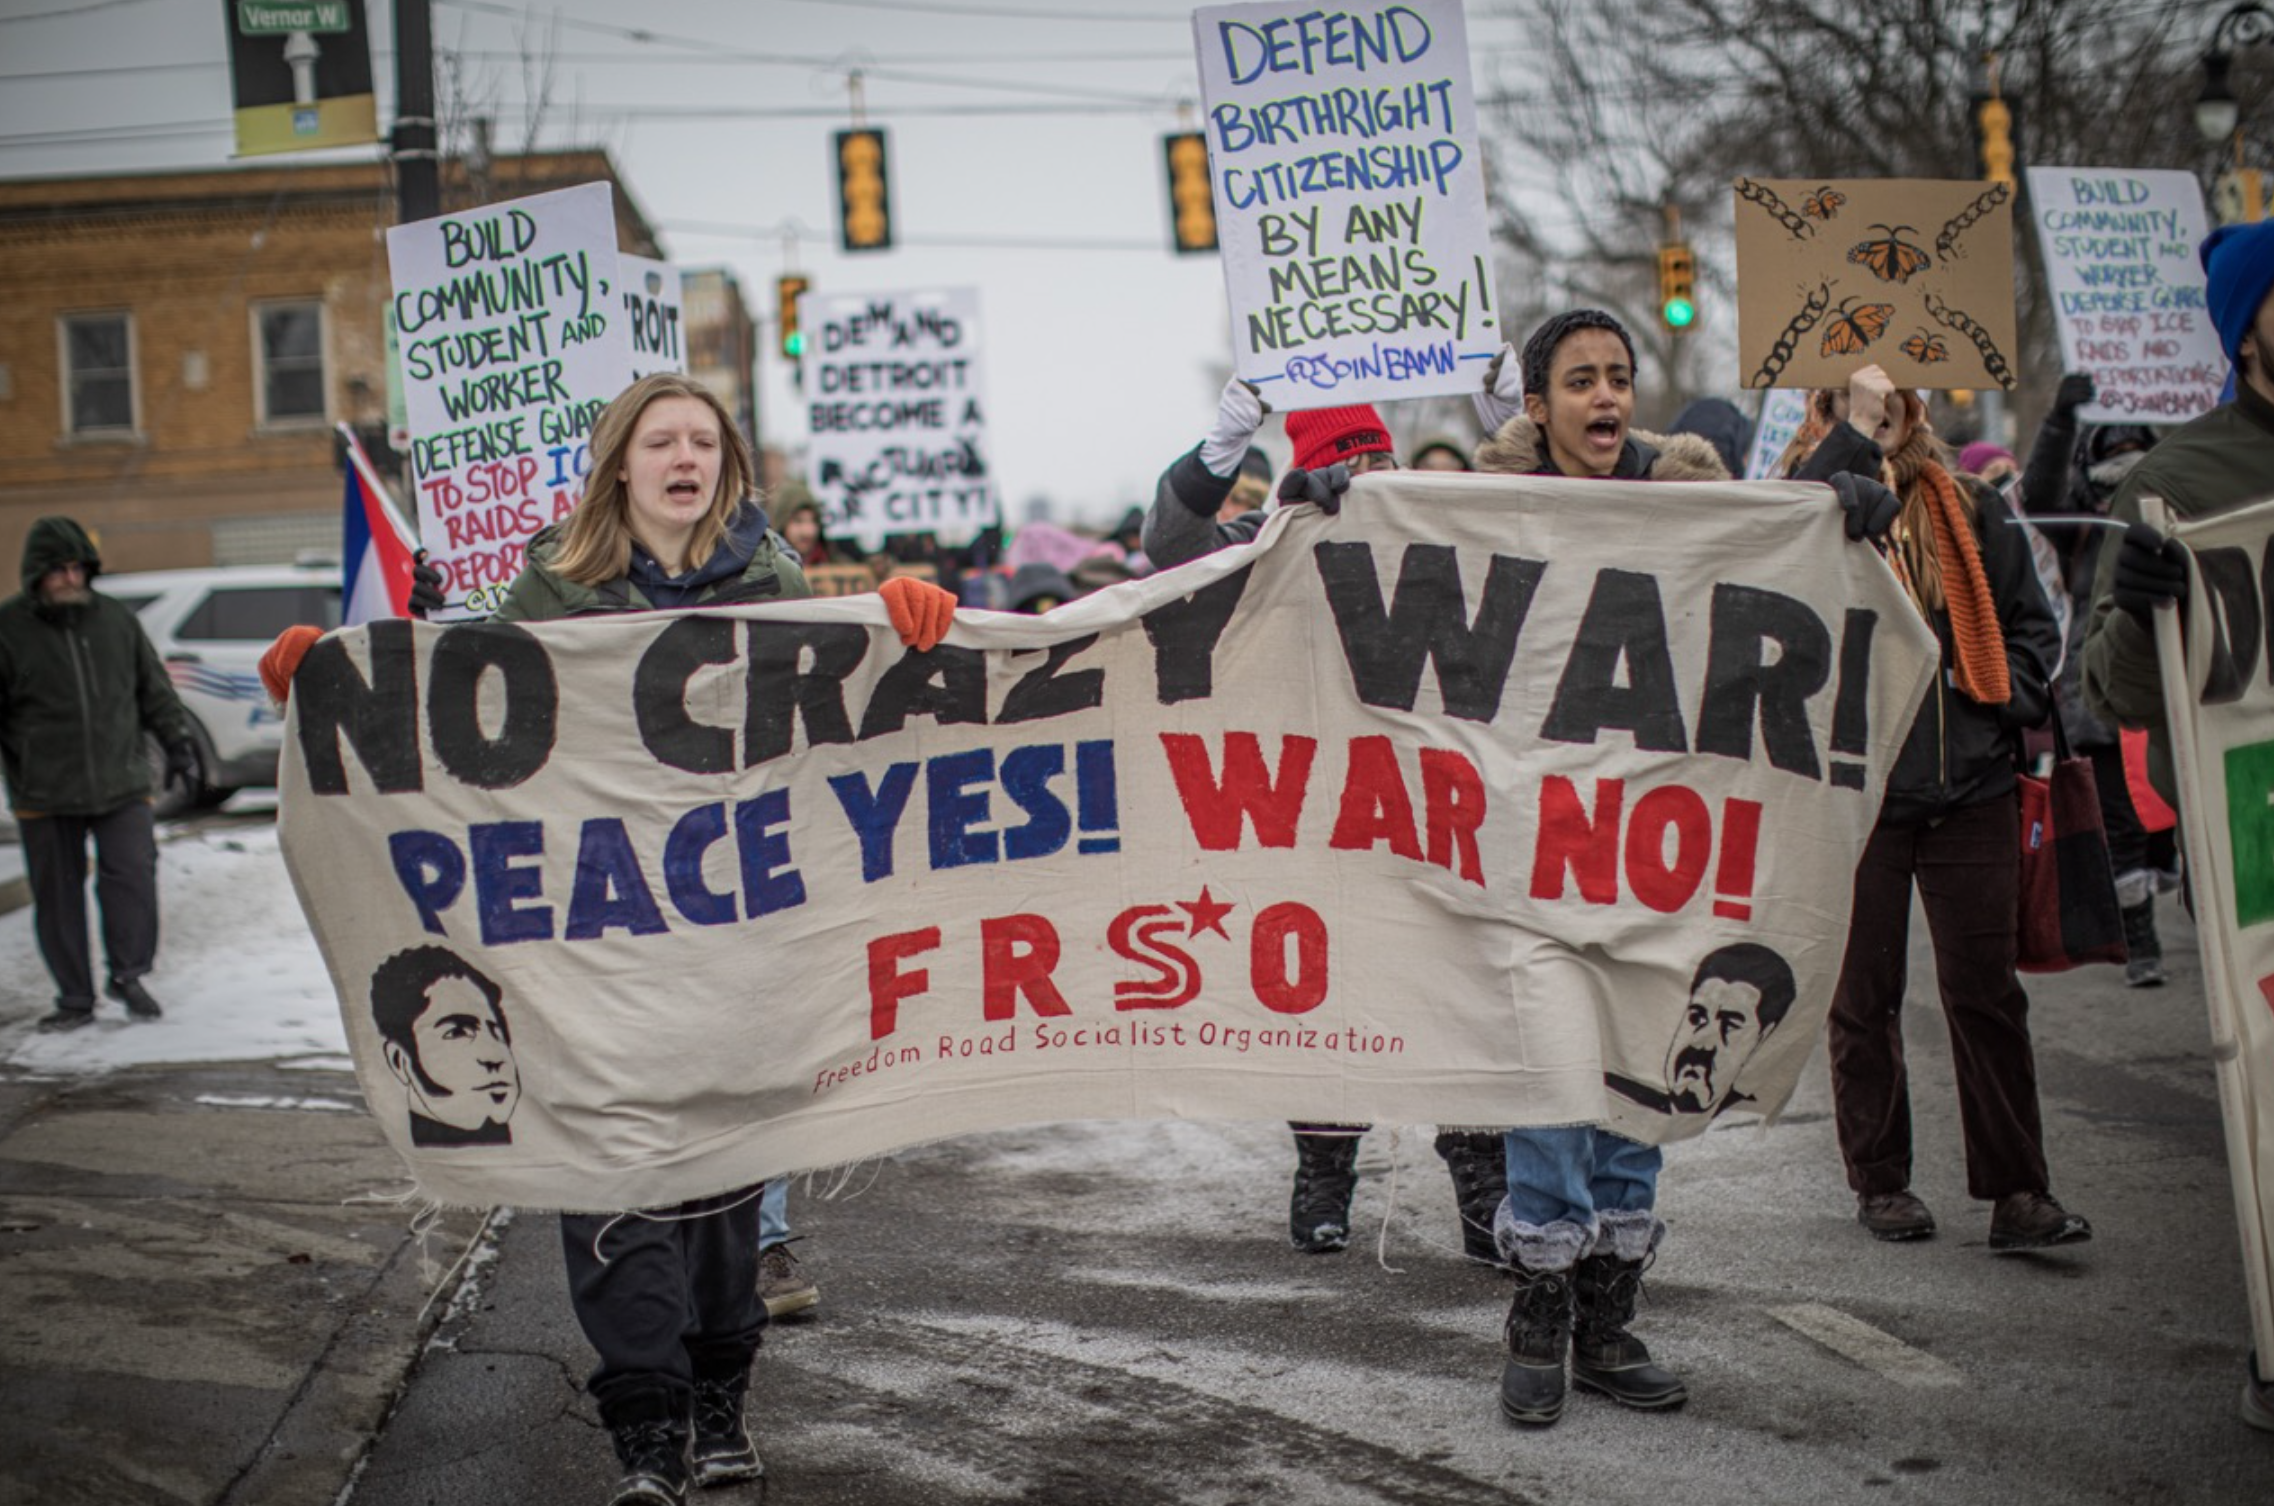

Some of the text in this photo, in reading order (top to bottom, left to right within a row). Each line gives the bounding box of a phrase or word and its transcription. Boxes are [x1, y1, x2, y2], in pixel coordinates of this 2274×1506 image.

[244, 4, 338, 27] Vernor W
[1218, 6, 1432, 85] DEFEND
[1211, 79, 1452, 153] BIRTHRIGHT
[1223, 140, 1463, 209] CITIZENSHIP
[2071, 177, 2150, 205] BUILD
[439, 208, 537, 268] BUILD
[1258, 196, 1422, 257] BY ANY
[2055, 236, 2151, 261] STUDENT
[396, 251, 609, 333] COMMUNITY,
[1248, 255, 1493, 354] NECESSARY!
[1269, 245, 1437, 304] MEANS
[407, 311, 550, 380] STUDENT
[561, 313, 606, 349] AND
[823, 302, 961, 352] DEMAND
[2151, 312, 2196, 333] ICE
[440, 360, 570, 421] WORKER
[820, 359, 968, 393] DETROIT
[810, 398, 983, 432] BECOME A
[413, 417, 532, 479] DEFENSE
[422, 476, 463, 518] TO
[466, 456, 538, 503] STOP
[444, 500, 544, 549] RAIDS
[292, 619, 559, 794] NO
[1313, 540, 1880, 792] WAR!
[388, 731, 1763, 945] PEACE YES! WAR NO!
[812, 1022, 1405, 1094] Freedom Road Socialist Organization
